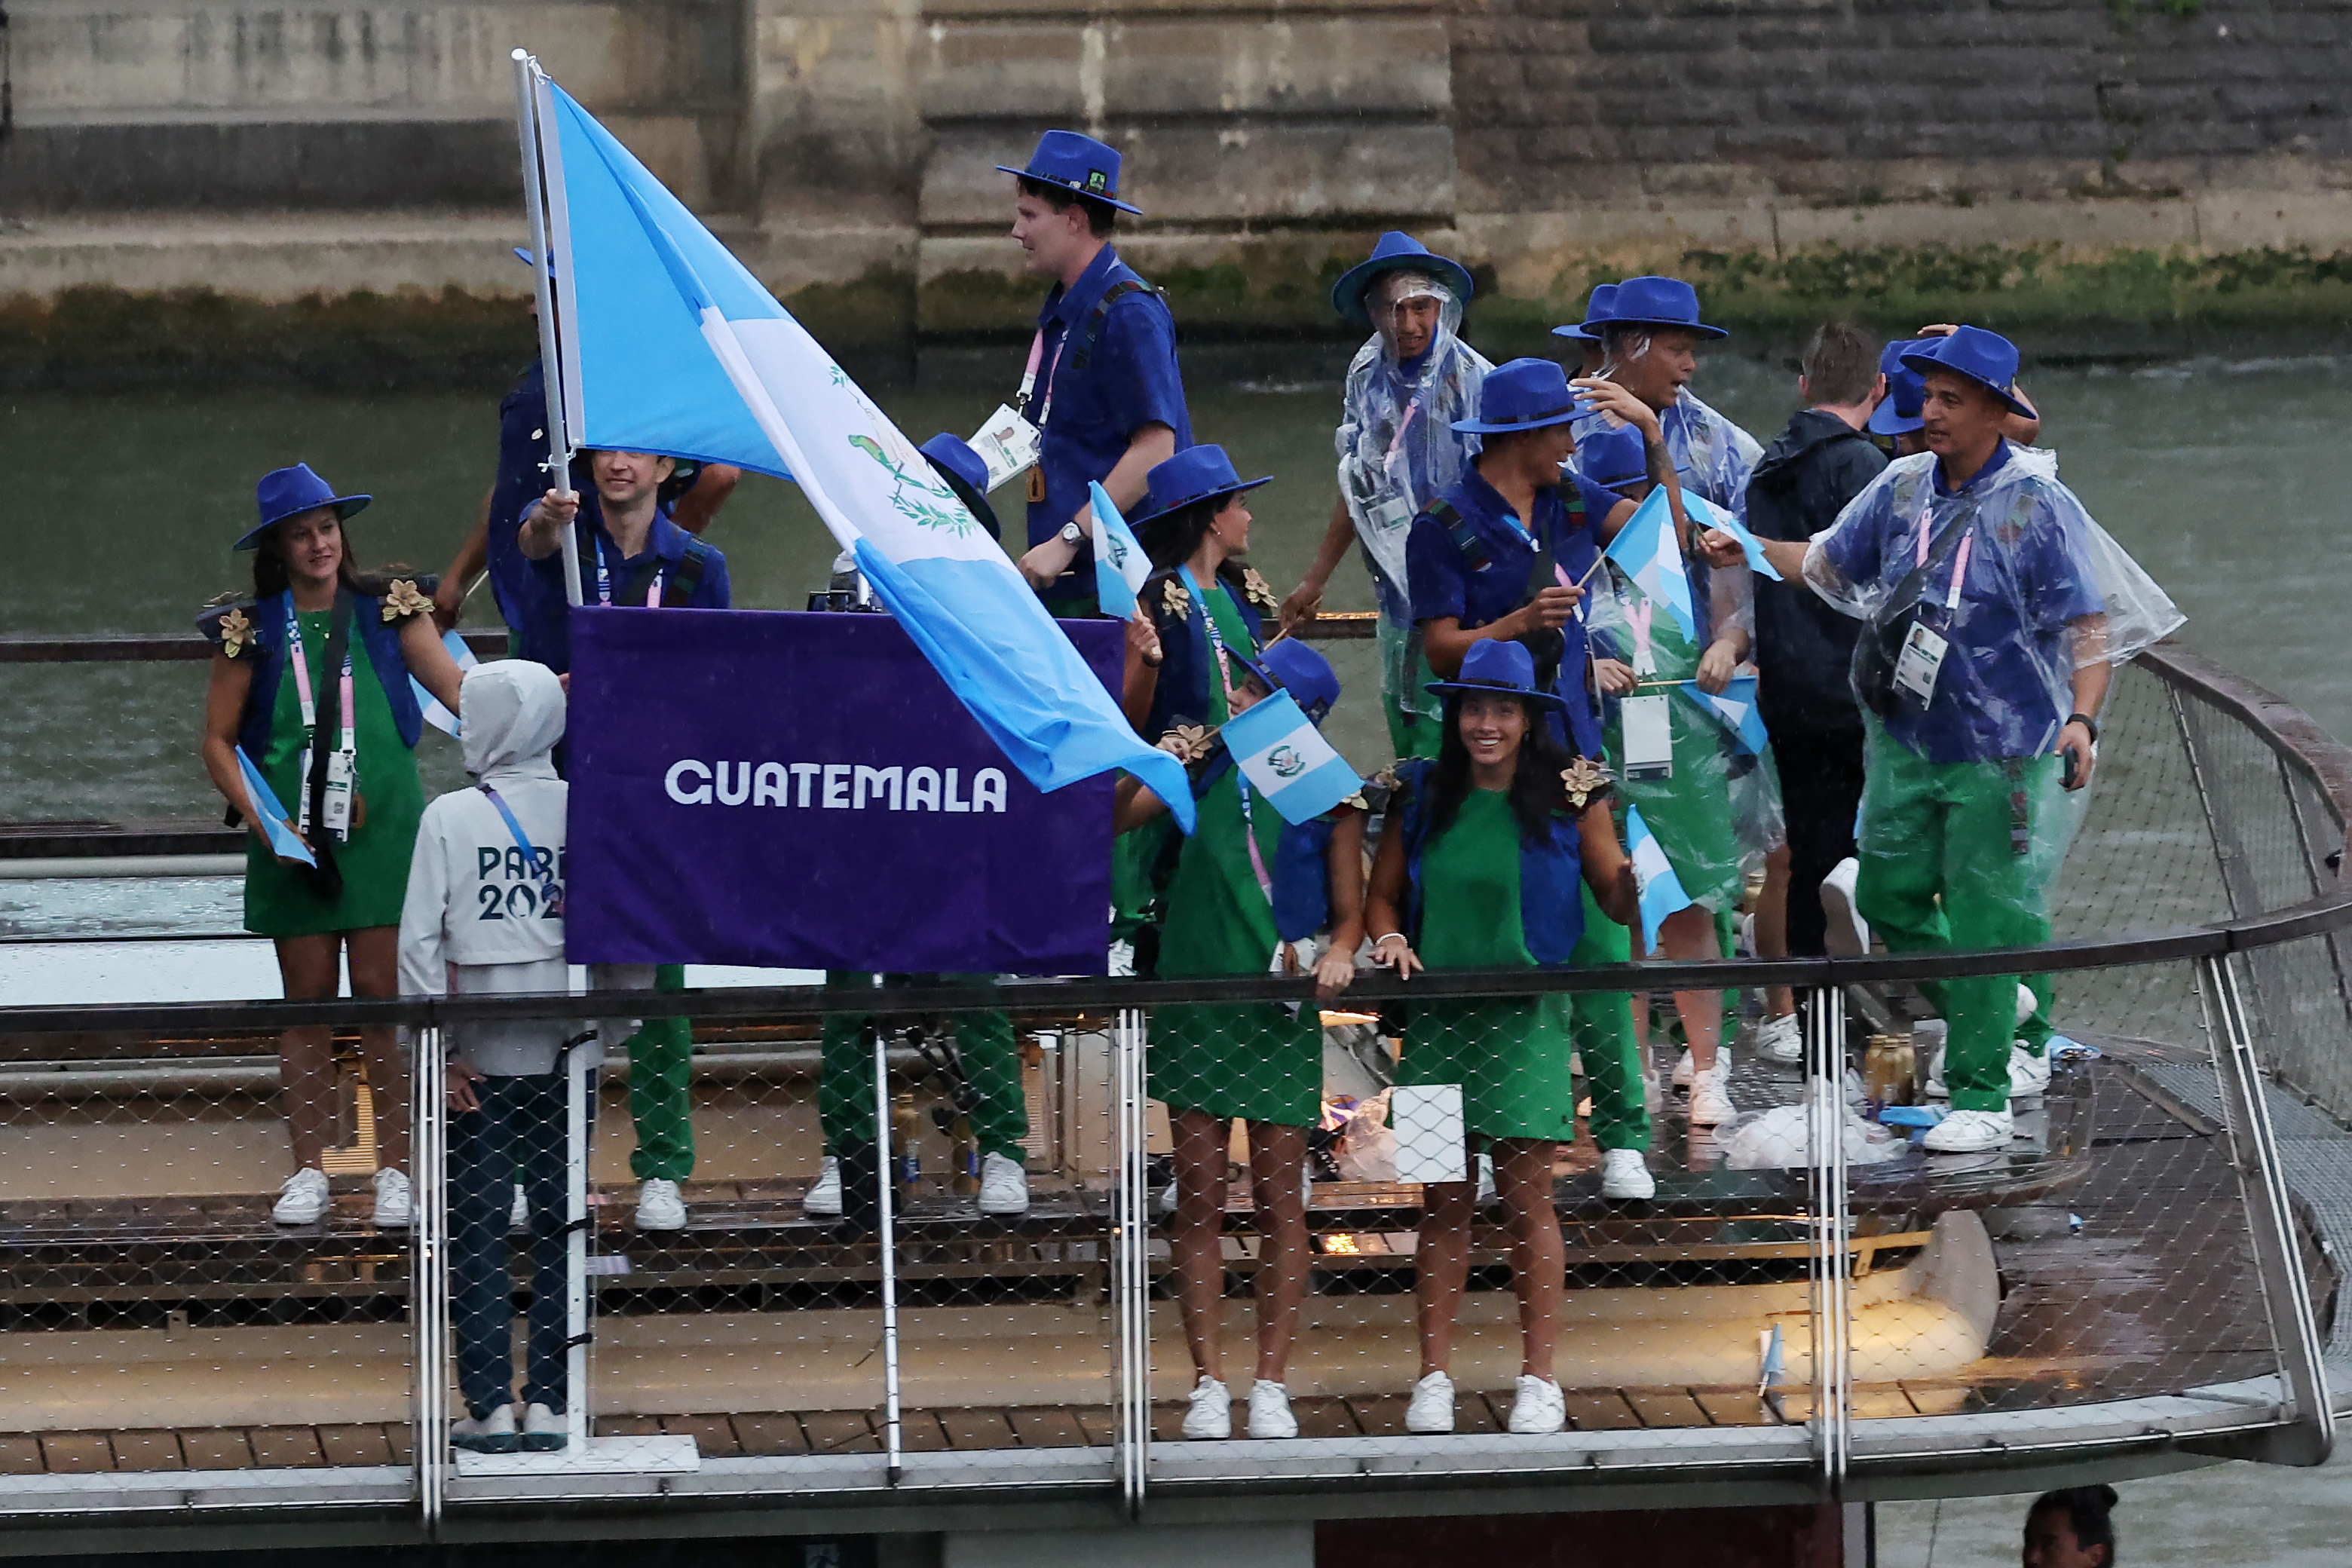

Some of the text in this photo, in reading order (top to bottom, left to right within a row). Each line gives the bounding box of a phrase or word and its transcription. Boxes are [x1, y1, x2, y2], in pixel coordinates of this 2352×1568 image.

[664, 759, 1008, 813] GUATEMALA
[478, 846, 565, 883] PARI
[479, 884, 564, 920] 202
